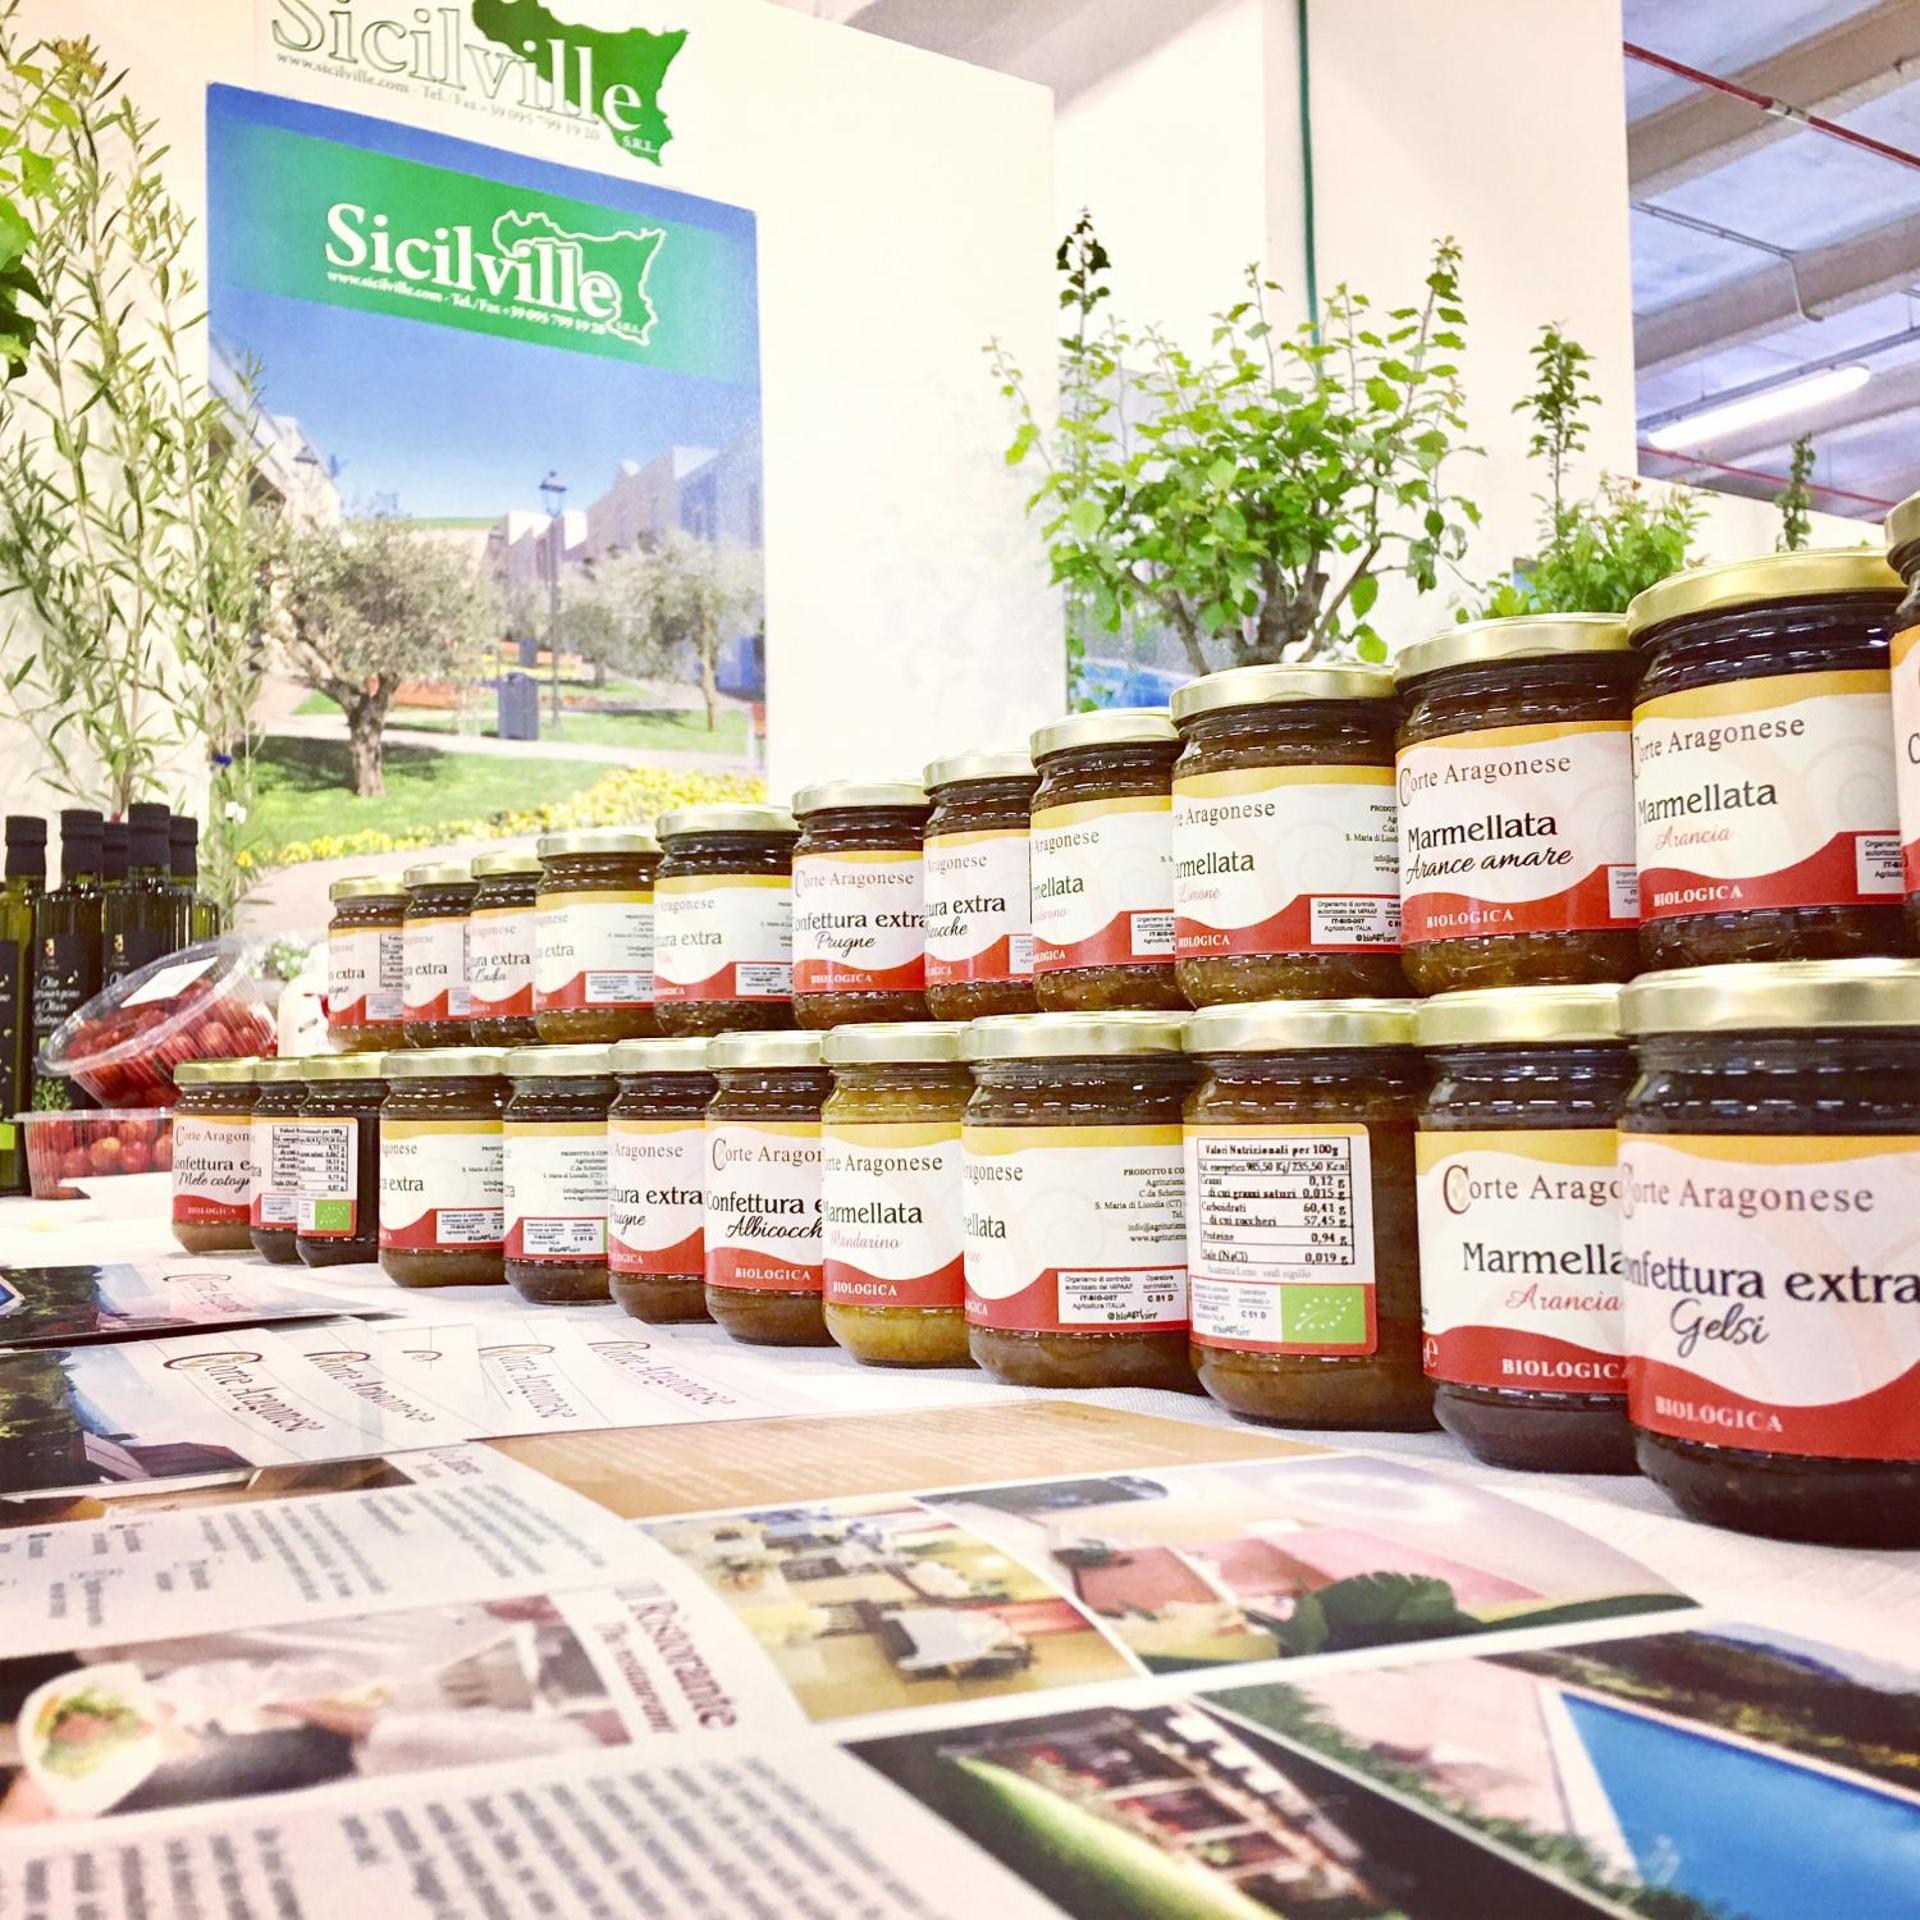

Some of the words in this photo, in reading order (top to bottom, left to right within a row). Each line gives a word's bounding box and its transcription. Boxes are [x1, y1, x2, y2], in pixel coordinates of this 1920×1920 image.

[272, 0, 642, 131] Sicilville
[326, 202, 616, 318] Sicilville
[1667, 718, 1806, 752] Aragonese
[1400, 767, 1438, 808] Corte
[1443, 755, 1572, 786] Aragonese
[1185, 800, 1276, 828] Aragonese
[1638, 780, 1778, 828] Marmellata
[1407, 813, 1558, 852] Marmellata
[1654, 824, 1735, 850] Arancia
[1174, 848, 1256, 878] armellata
[1406, 850, 1477, 883] Arance
[1479, 847, 1575, 869] amare
[830, 871, 914, 889] Aragonese
[953, 893, 1006, 915] extra
[1654, 884, 1743, 908] BIOLOGICA
[794, 911, 868, 931] onfettura
[1425, 908, 1514, 928] BIOLOGICA
[681, 929, 722, 945] extra
[815, 931, 877, 959] Prugne
[491, 951, 531, 966] extra
[544, 942, 575, 957] extra
[336, 967, 366, 980] extra
[415, 961, 448, 976] extra
[203, 1130, 250, 1144] Aragon
[712, 1138, 752, 1171] Corte
[758, 1145, 822, 1167] Arago
[1205, 1144, 1228, 1154] Valori
[1229, 1144, 1289, 1154] Nutrizionali
[1292, 1146, 1310, 1157] per
[1313, 1144, 1339, 1157] 100g
[174, 1156, 234, 1172] onfettura
[845, 1153, 943, 1176] Aragonese
[209, 1173, 251, 1194] cotog
[388, 1175, 424, 1192] extra
[1308, 1175, 1334, 1188] 0,12
[1442, 1164, 1519, 1215] Corte
[1528, 1174, 1621, 1207] Arago
[645, 1185, 704, 1205] extra
[706, 1190, 805, 1214] Confettura
[1104, 1200, 1127, 1209] Maria
[1679, 1178, 1875, 1219] Aragonese
[726, 1214, 822, 1239] Albicocch
[964, 1214, 1007, 1240] ellata
[1303, 1215, 1336, 1227] 57,45
[830, 1229, 902, 1250] Mandarino
[1311, 1232, 1336, 1245] 0,94
[1305, 1251, 1337, 1264] 0,019
[1462, 1242, 1623, 1275] Marmella
[734, 1266, 812, 1281] BIOLOGICA
[1622, 1249, 1765, 1300] nfettura
[1784, 1264, 1920, 1303] extra
[832, 1280, 898, 1297] BIOLOGICA
[1505, 1282, 1623, 1312] Arancia
[1670, 1300, 1770, 1359] Gelsi
[1655, 1396, 1784, 1433] BIOLOGICA
